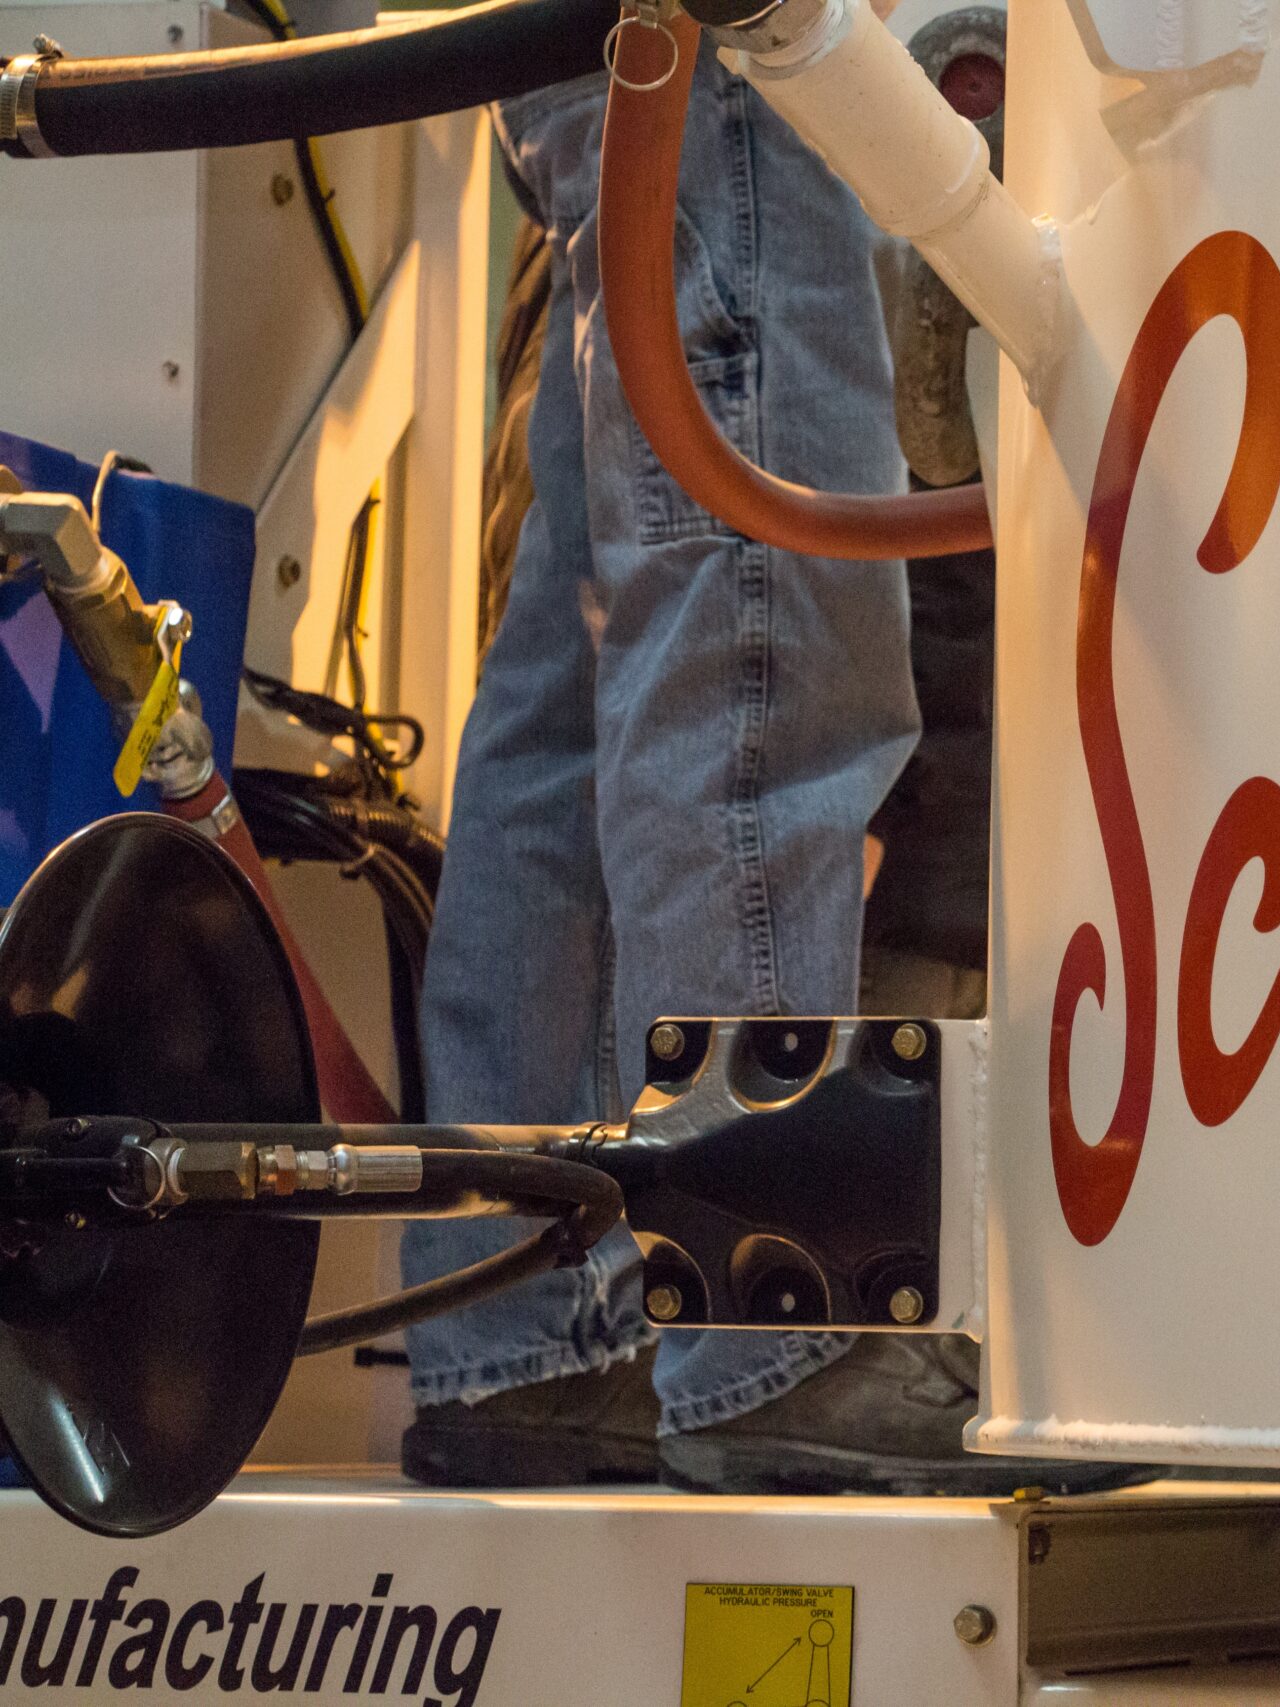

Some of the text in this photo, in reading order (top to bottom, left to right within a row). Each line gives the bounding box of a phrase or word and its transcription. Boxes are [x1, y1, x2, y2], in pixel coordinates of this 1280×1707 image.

[806, 1588, 834, 1598] VALVE
[719, 1597, 817, 1607] HYDRAULIC PRESSURE
[810, 1609, 833, 1618] OPEN
